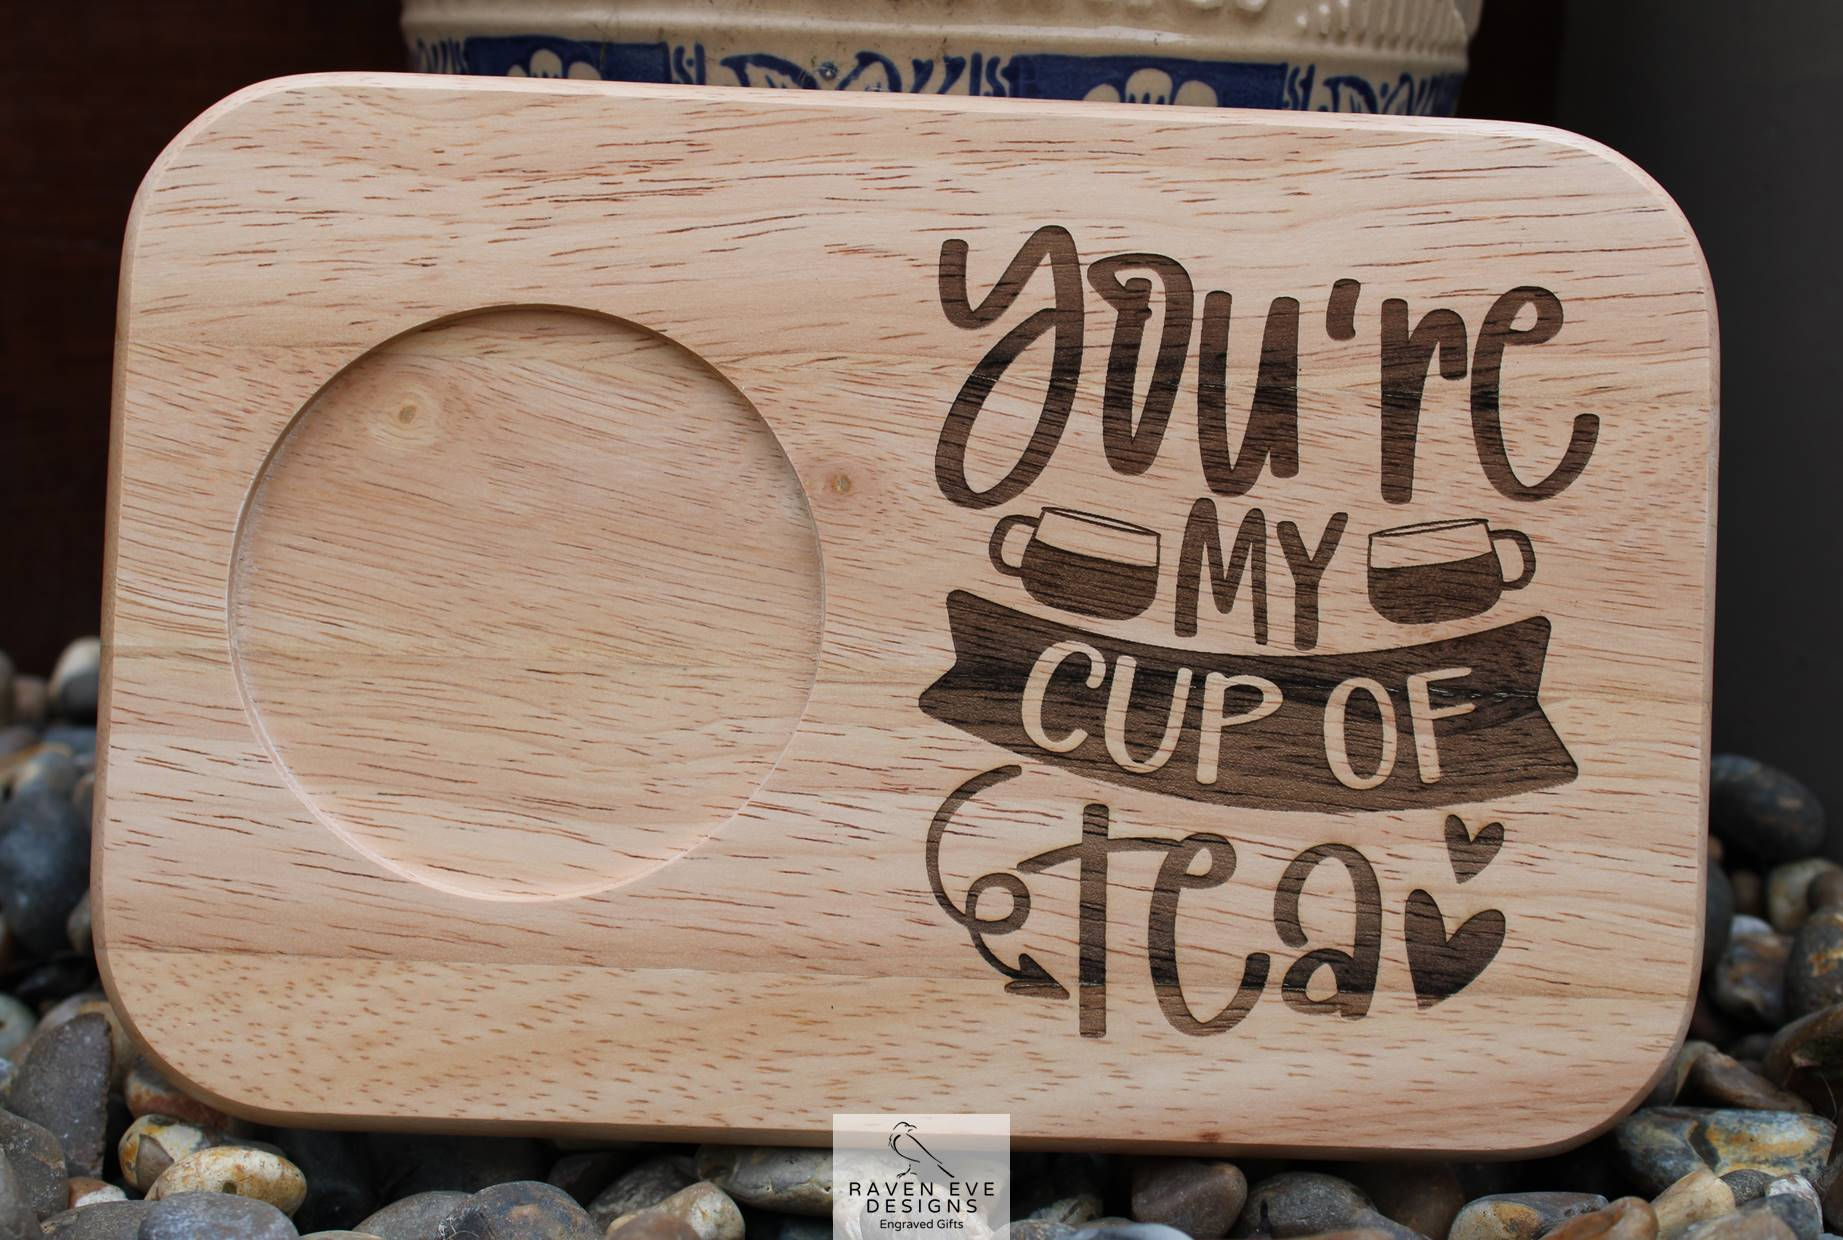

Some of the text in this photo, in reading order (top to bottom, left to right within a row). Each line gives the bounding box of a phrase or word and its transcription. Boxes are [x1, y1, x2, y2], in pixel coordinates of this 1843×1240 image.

[1174, 497, 1349, 651] MY
[1020, 640, 1477, 791] CUP OF
